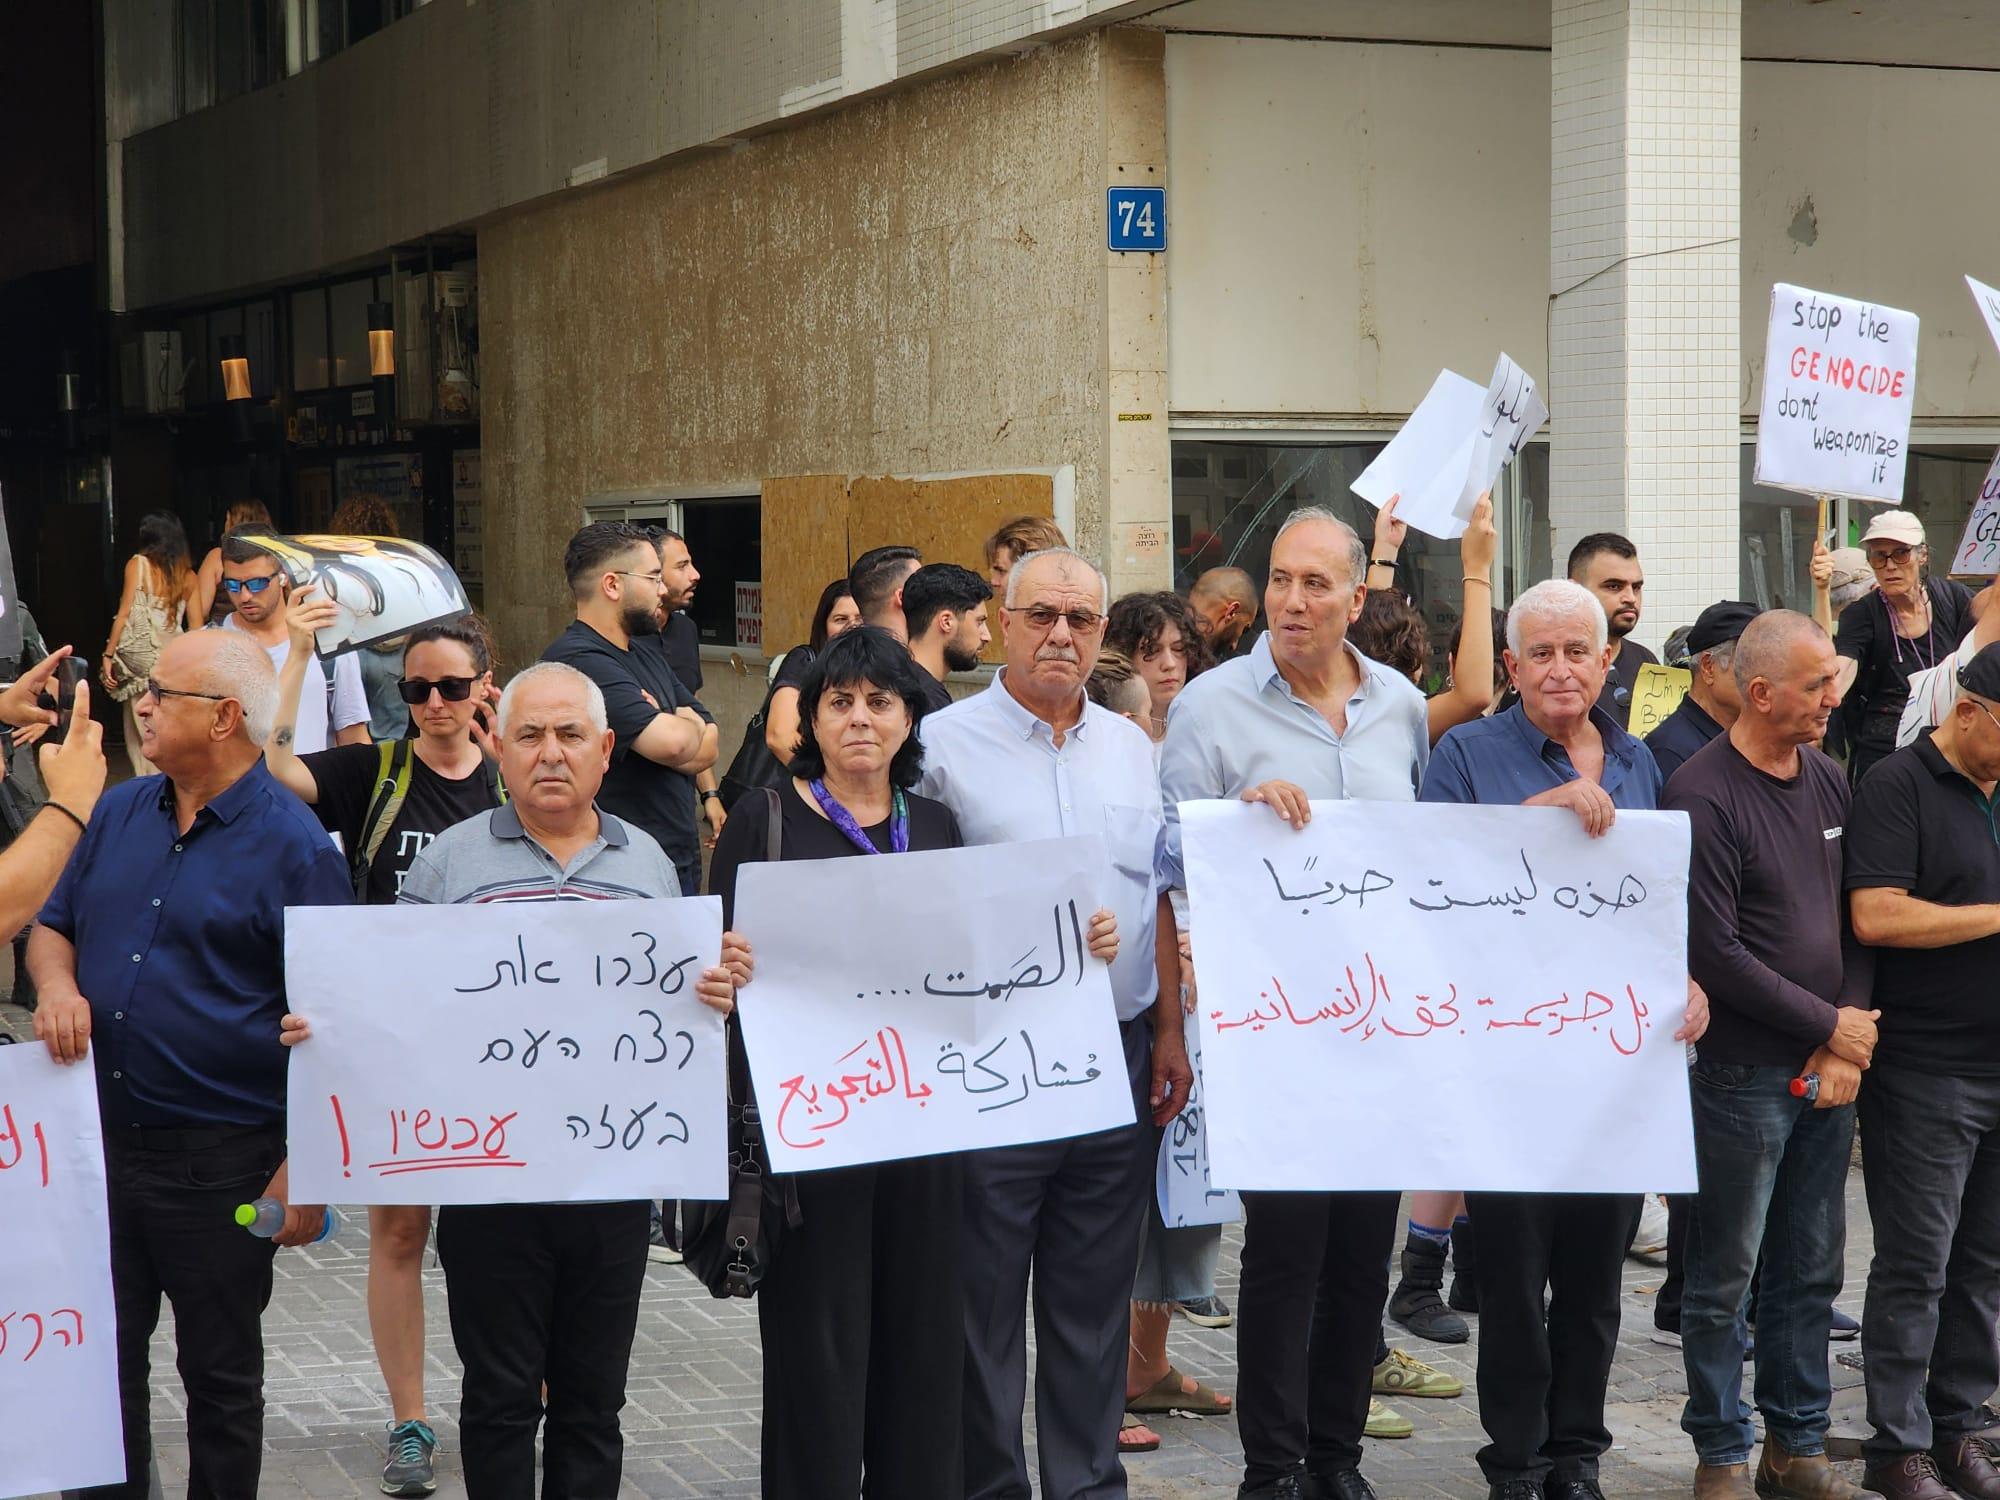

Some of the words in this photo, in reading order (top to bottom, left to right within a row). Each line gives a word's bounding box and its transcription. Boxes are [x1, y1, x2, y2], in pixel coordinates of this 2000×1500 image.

[1118, 201, 1156, 237] 74
[1792, 296, 1842, 343] stop
[1858, 306, 1889, 342] the
[1791, 347, 1905, 397] GENOCIDE
[1778, 388, 1819, 421] dont
[1872, 458, 1887, 484] it
[1973, 502, 1991, 519] of
[1409, 848, 1537, 915] ليست
[454, 934, 560, 992] את
[594, 931, 698, 994] עצרו
[1382, 983, 1465, 1037] بحق
[1477, 990, 1613, 1035] جريمة
[1610, 984, 1651, 1055] بل
[478, 1028, 580, 1069] העם
[614, 1010, 694, 1070] רצח
[391, 1109, 518, 1157] עכשיו
[566, 1102, 690, 1150] בעזה
